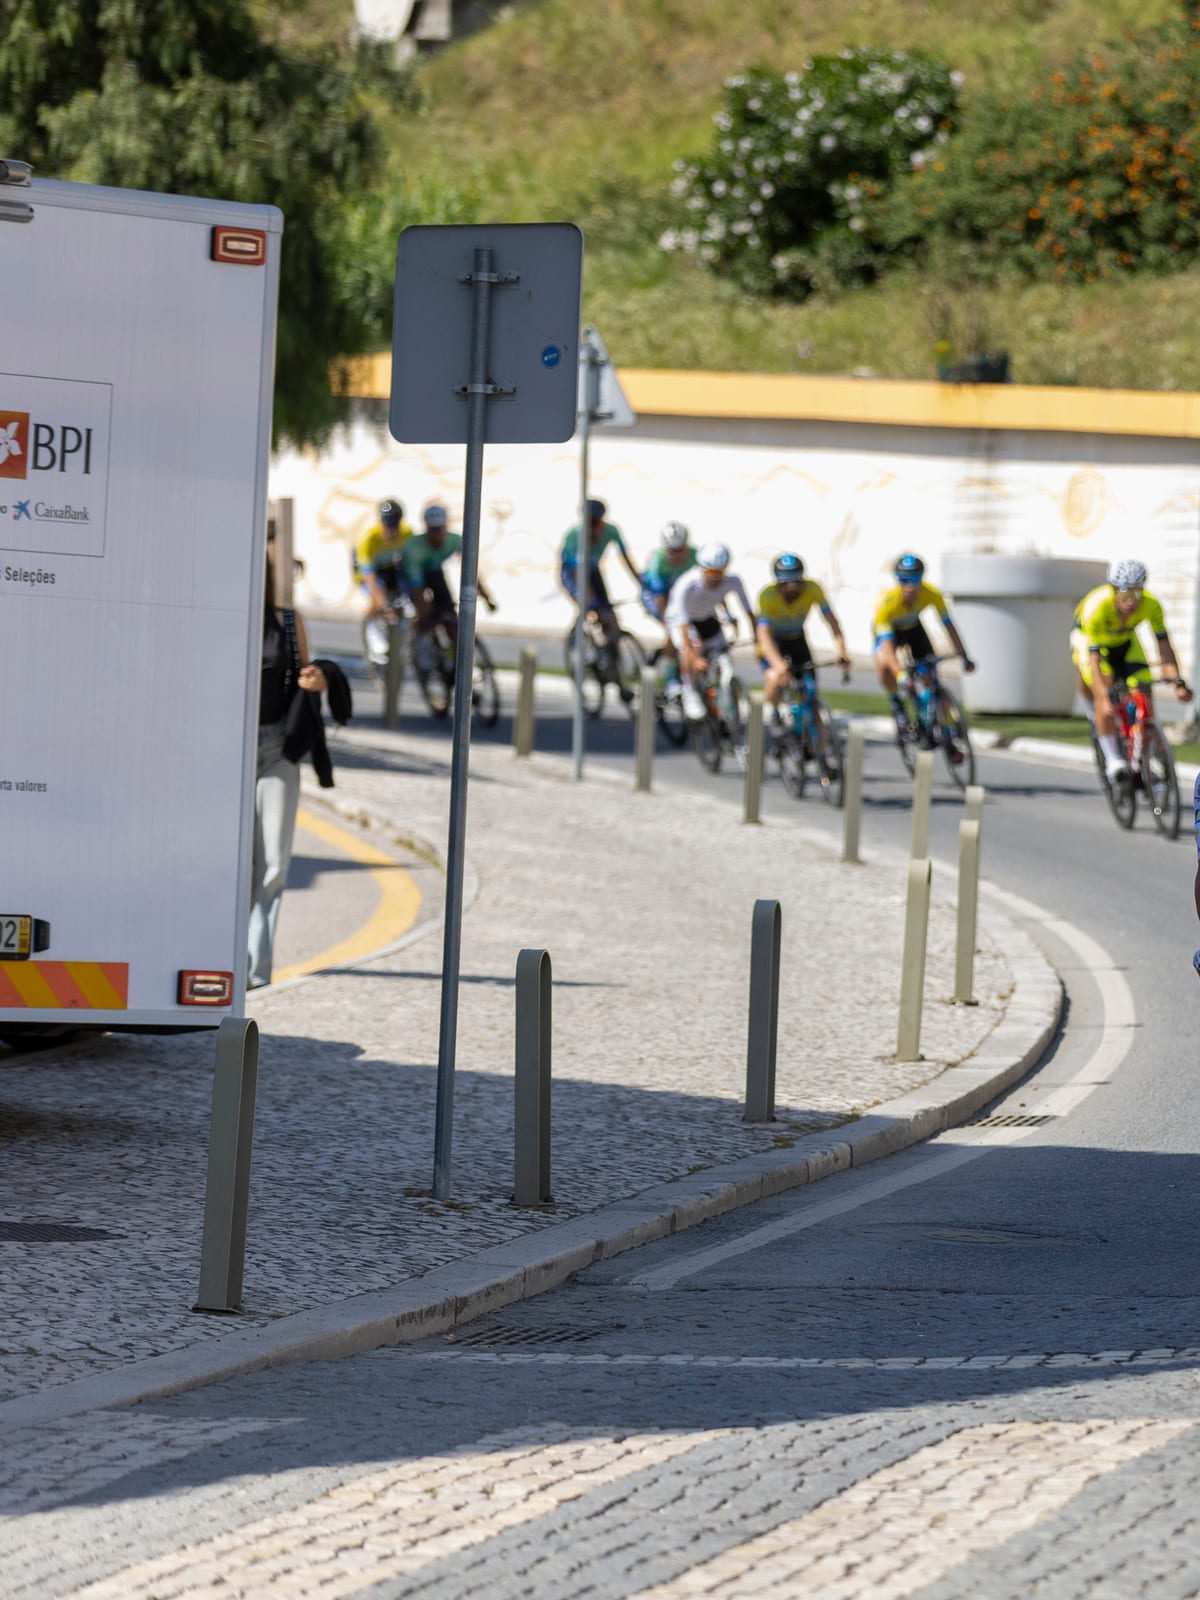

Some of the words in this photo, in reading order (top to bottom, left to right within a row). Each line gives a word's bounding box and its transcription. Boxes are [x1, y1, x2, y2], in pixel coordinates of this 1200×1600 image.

[32, 423, 93, 474] BPI
[34, 502, 90, 521] CaixaBank
[5, 566, 56, 587] Seleções
[15, 780, 47, 792] valores
[0, 920, 16, 947] 2
